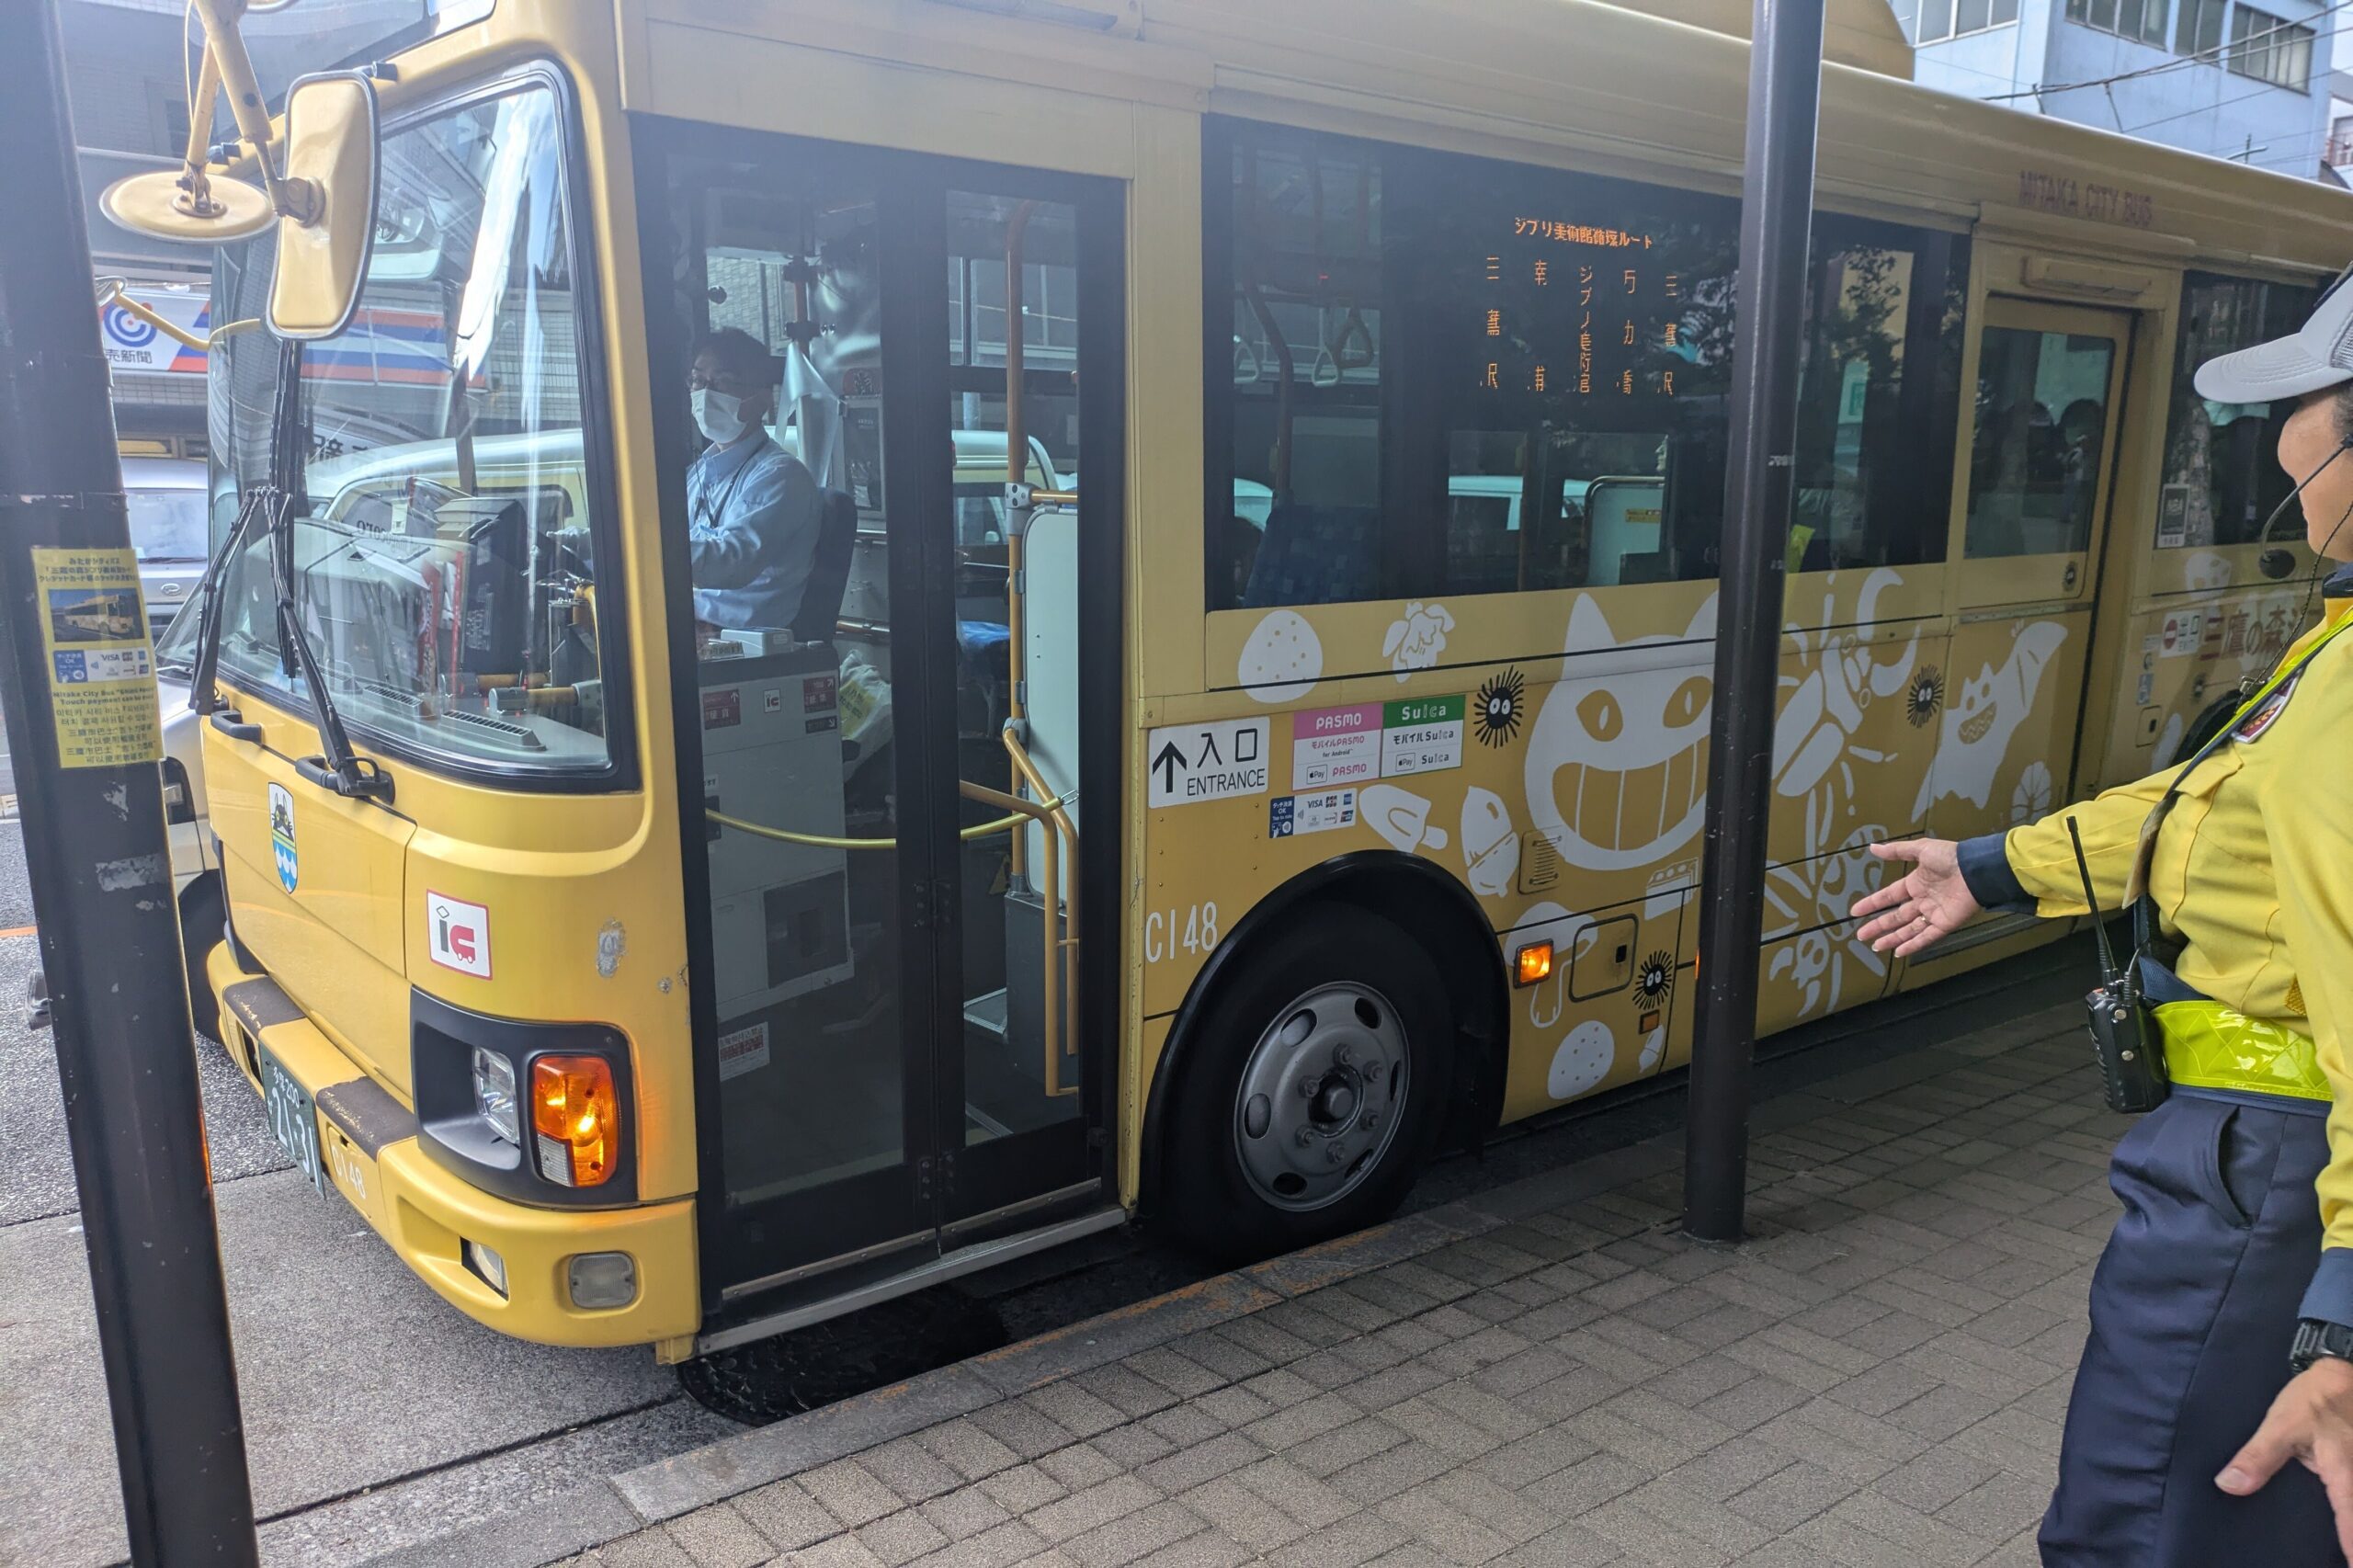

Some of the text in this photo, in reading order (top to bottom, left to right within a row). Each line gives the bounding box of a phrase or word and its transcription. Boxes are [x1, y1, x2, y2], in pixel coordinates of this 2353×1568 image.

[1402, 705, 1447, 721] Suica
[1315, 712, 1362, 731] PASMO
[1312, 735, 1365, 750] モバイルPASMO
[1393, 729, 1454, 745] モバイルSuica
[1197, 728, 1258, 769] 入口
[1402, 753, 1449, 767] Pay Suica
[1313, 763, 1367, 778] Pay PASMO
[1187, 768, 1266, 797] ENTRANCE
[1307, 800, 1324, 809] VISA
